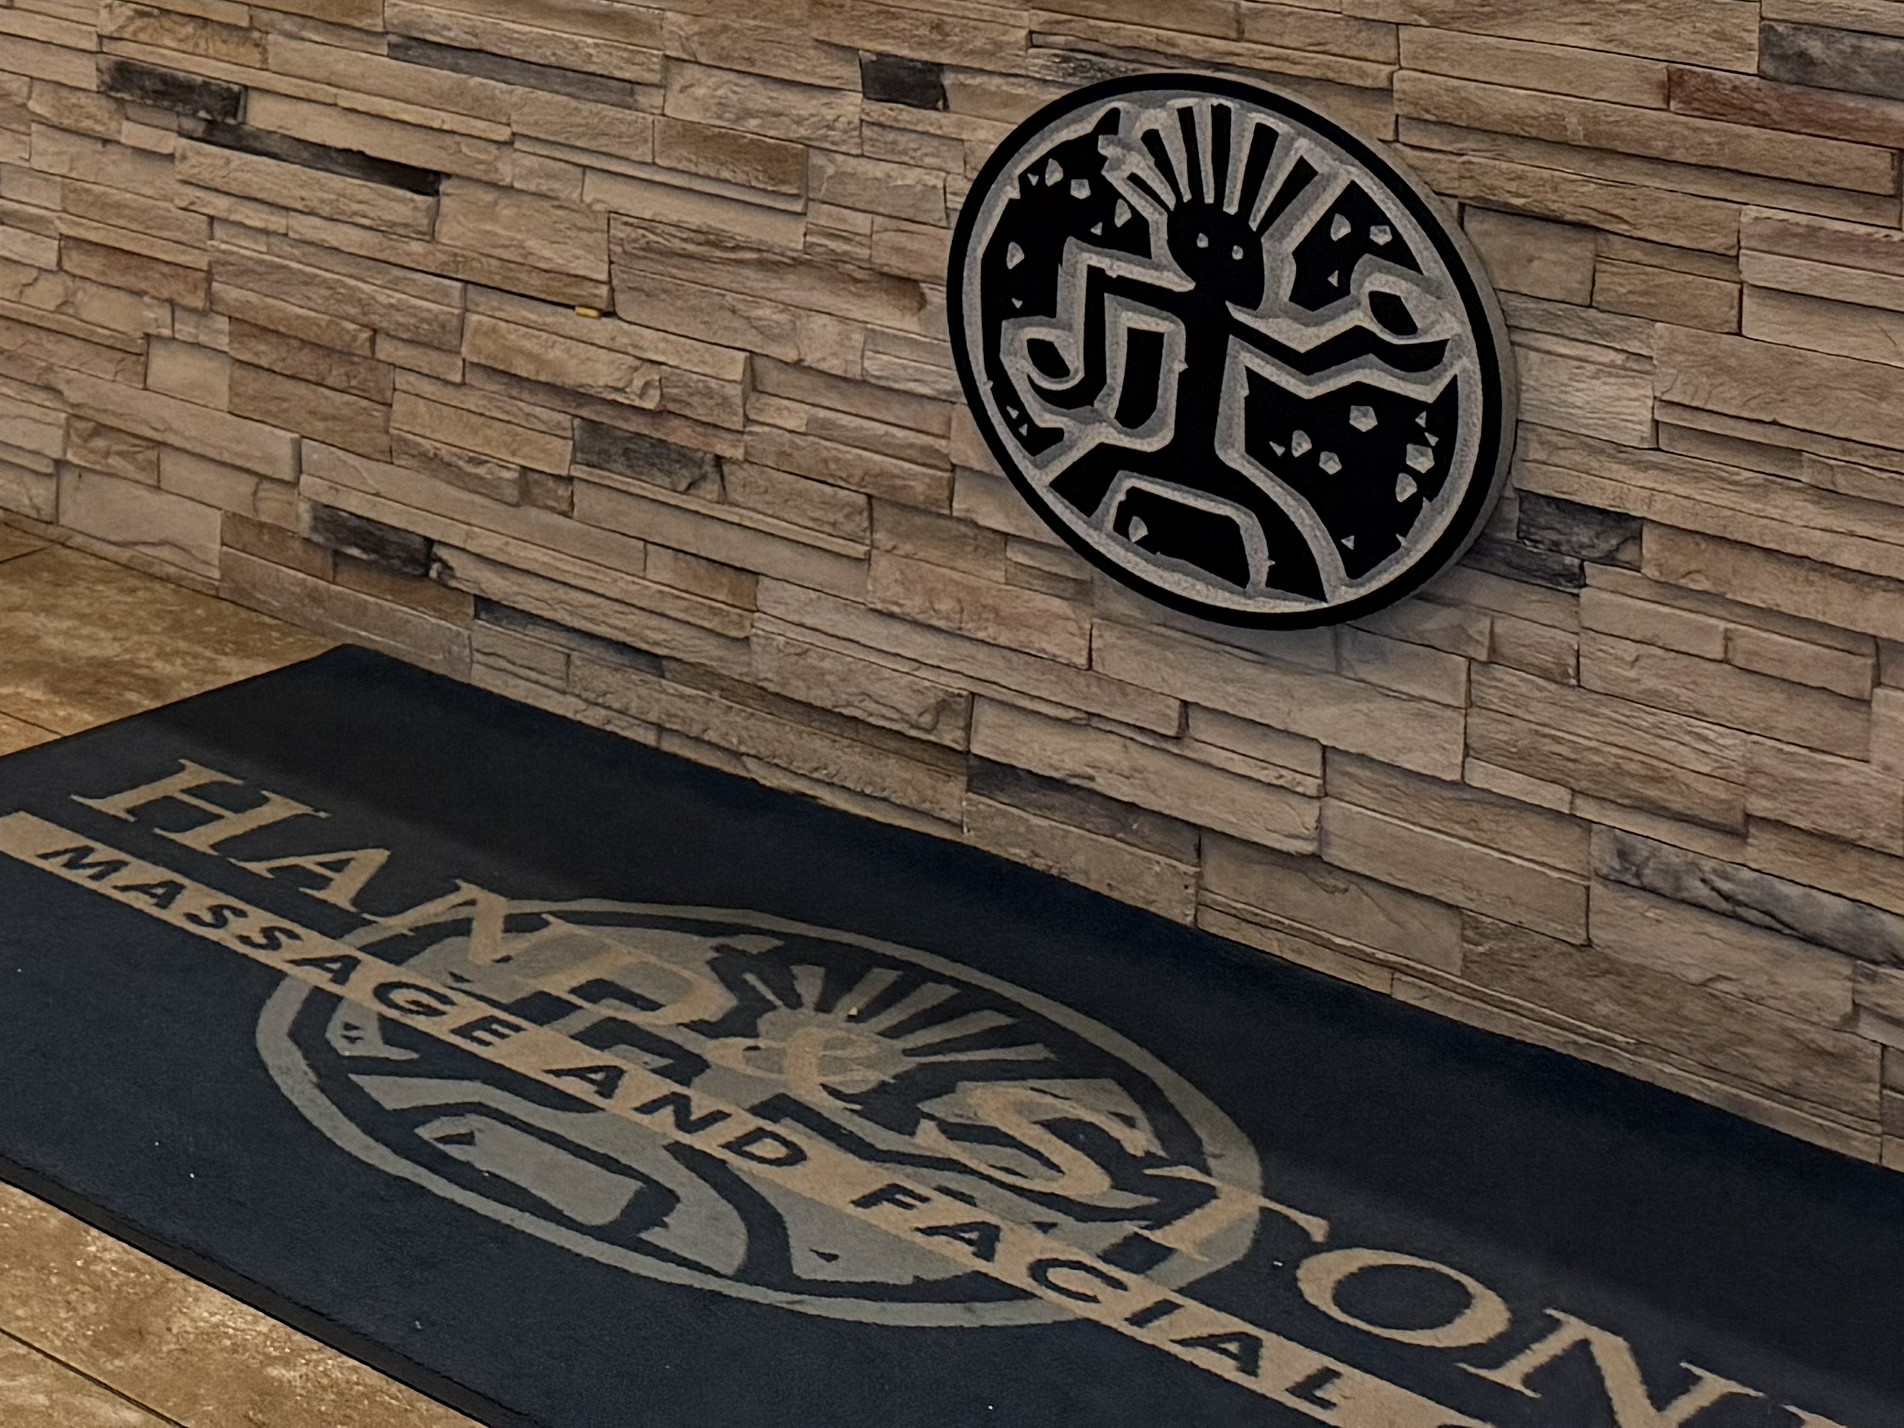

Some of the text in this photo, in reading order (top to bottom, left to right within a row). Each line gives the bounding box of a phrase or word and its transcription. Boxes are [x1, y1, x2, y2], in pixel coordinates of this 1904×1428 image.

[35, 844, 1343, 1410] MASSAGE AND FACIAL
[68, 758, 738, 1027] HAND
[914, 1083, 1852, 1428] STON
